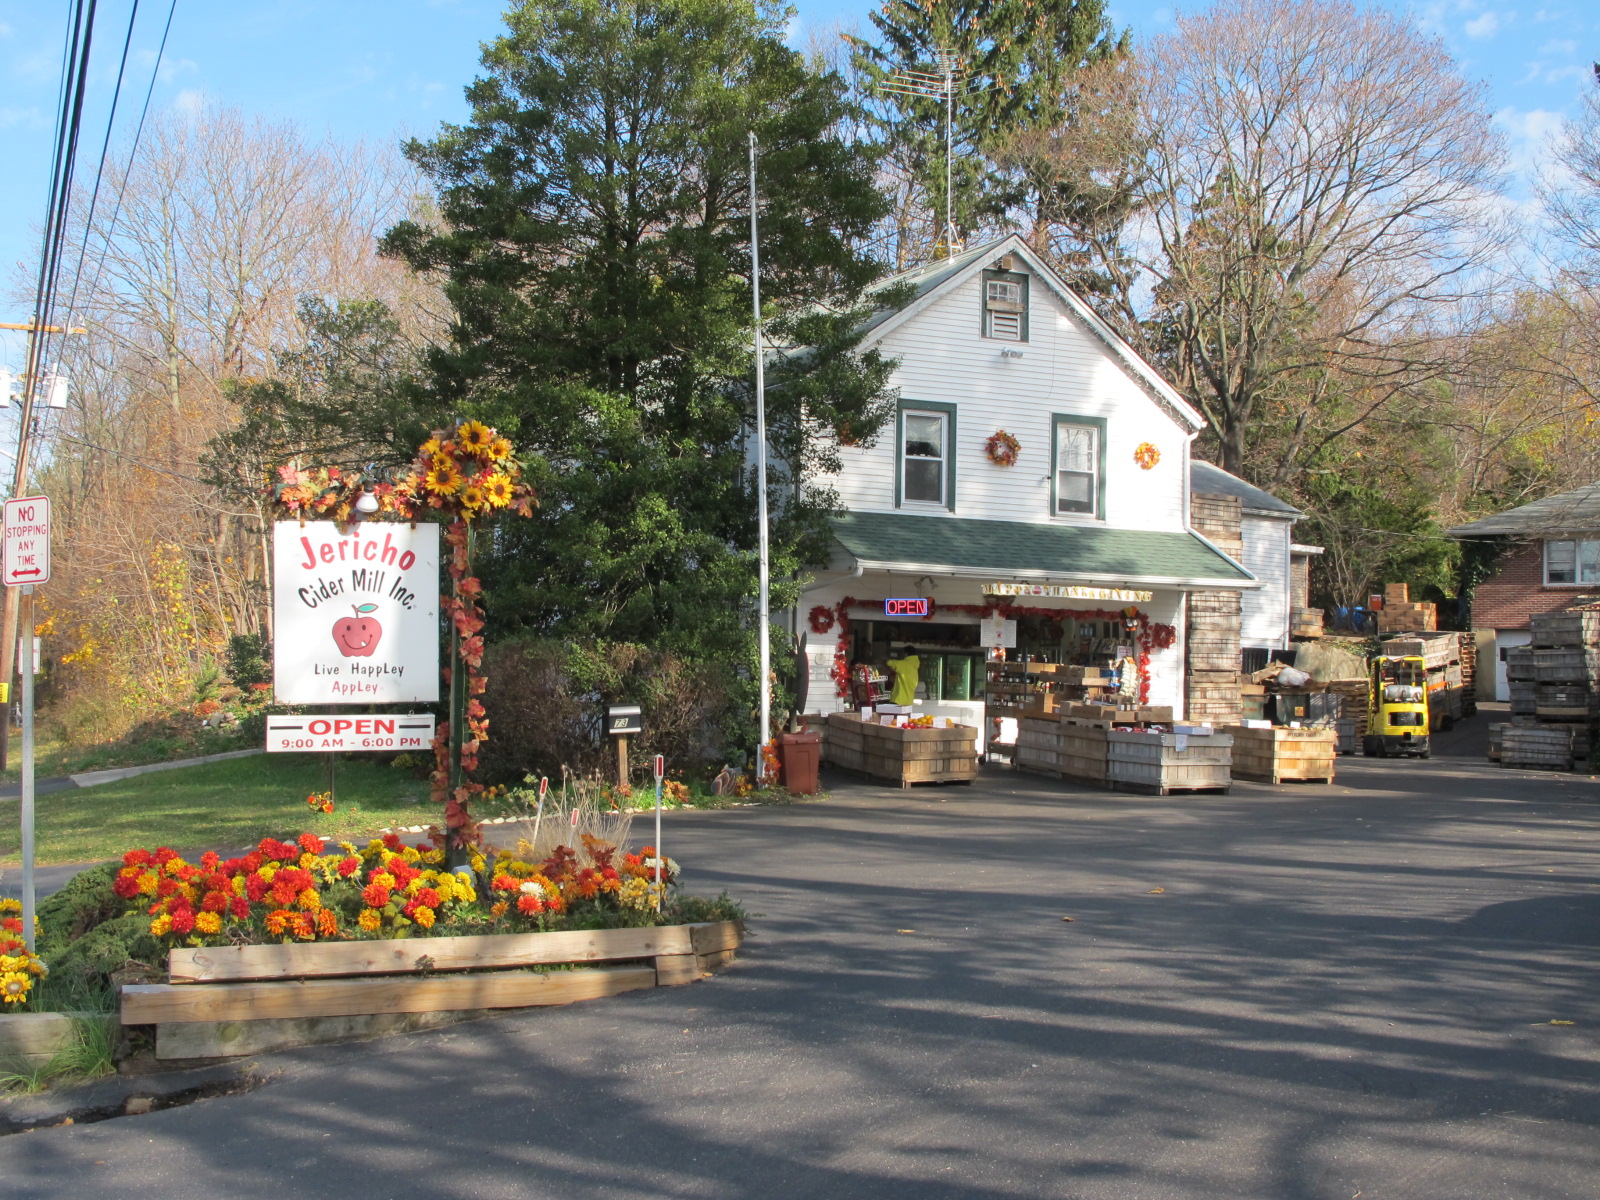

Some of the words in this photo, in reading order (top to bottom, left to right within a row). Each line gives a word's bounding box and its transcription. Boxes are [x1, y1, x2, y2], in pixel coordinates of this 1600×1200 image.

[18, 505, 35, 523] NO
[6, 523, 47, 539] STOPPING
[17, 539, 35, 552] ANY
[300, 532, 416, 571] Jericho
[17, 554, 35, 567] TIME
[298, 577, 344, 609] Cider
[352, 568, 385, 594] Mill
[388, 575, 416, 610] Inc.
[887, 599, 926, 615] OPEN
[314, 663, 340, 675] Live
[308, 719, 395, 735] OPEN
[615, 719, 627, 727] 73
[281, 738, 314, 748] 9:00
[321, 738, 343, 748] AM
[362, 738, 394, 747] 6:00
[400, 737, 421, 747] PM
